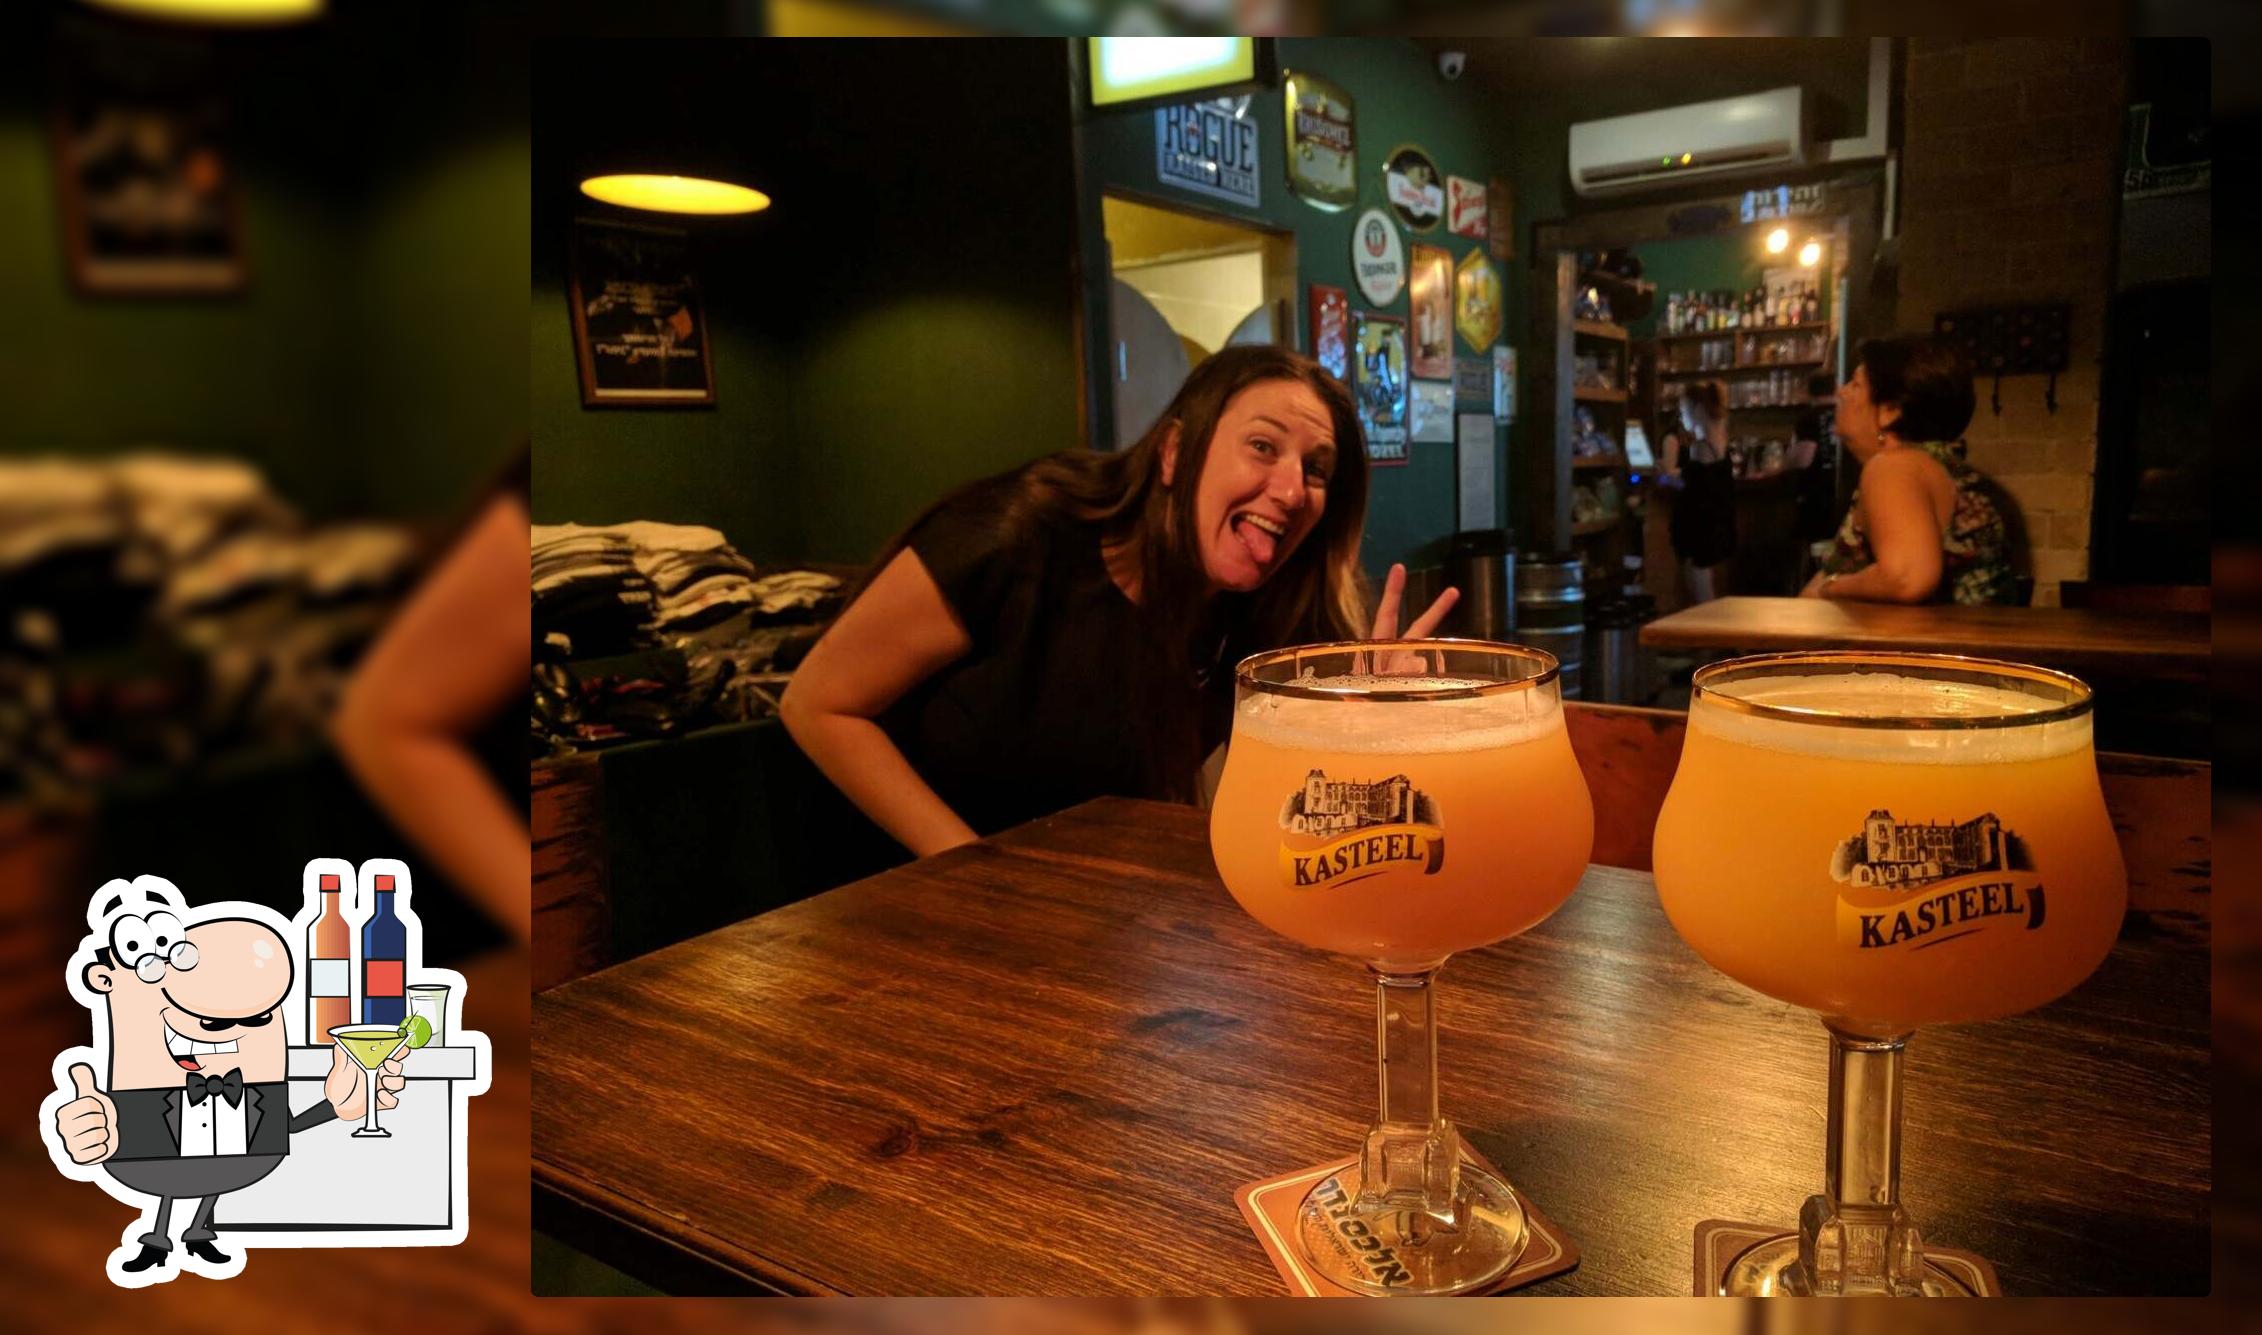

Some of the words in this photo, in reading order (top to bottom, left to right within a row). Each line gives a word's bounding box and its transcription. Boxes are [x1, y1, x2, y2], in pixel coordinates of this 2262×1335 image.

[1165, 105, 1253, 173] ROGUE
[1294, 834, 1423, 886] KASTEEL
[1859, 882, 2024, 949] KASTEEL
[1315, 1178, 1412, 1287] אלכסנדר
